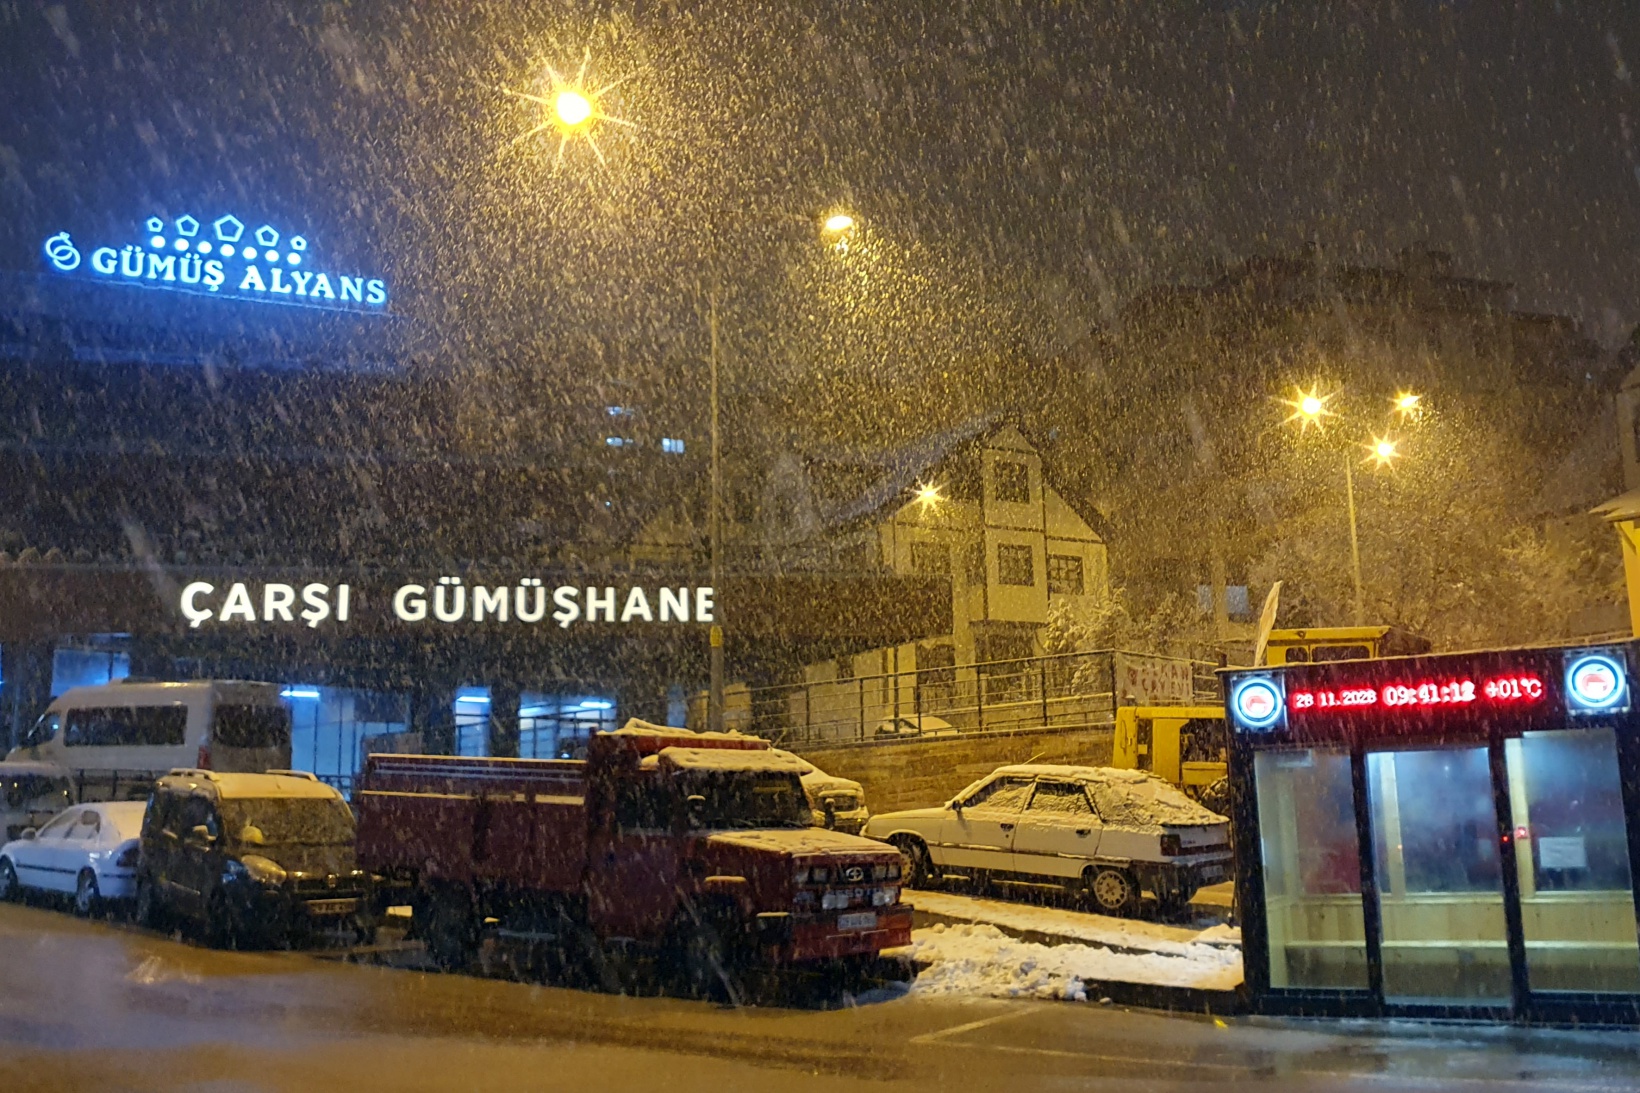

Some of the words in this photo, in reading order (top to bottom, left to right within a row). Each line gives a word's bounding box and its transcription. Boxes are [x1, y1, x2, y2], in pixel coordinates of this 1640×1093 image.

[91, 245, 225, 292] GÜMÜŞ
[239, 264, 387, 304] ALYANS
[180, 581, 350, 629] ÇARŞI
[394, 576, 714, 629] GÜMÜŞHANE
